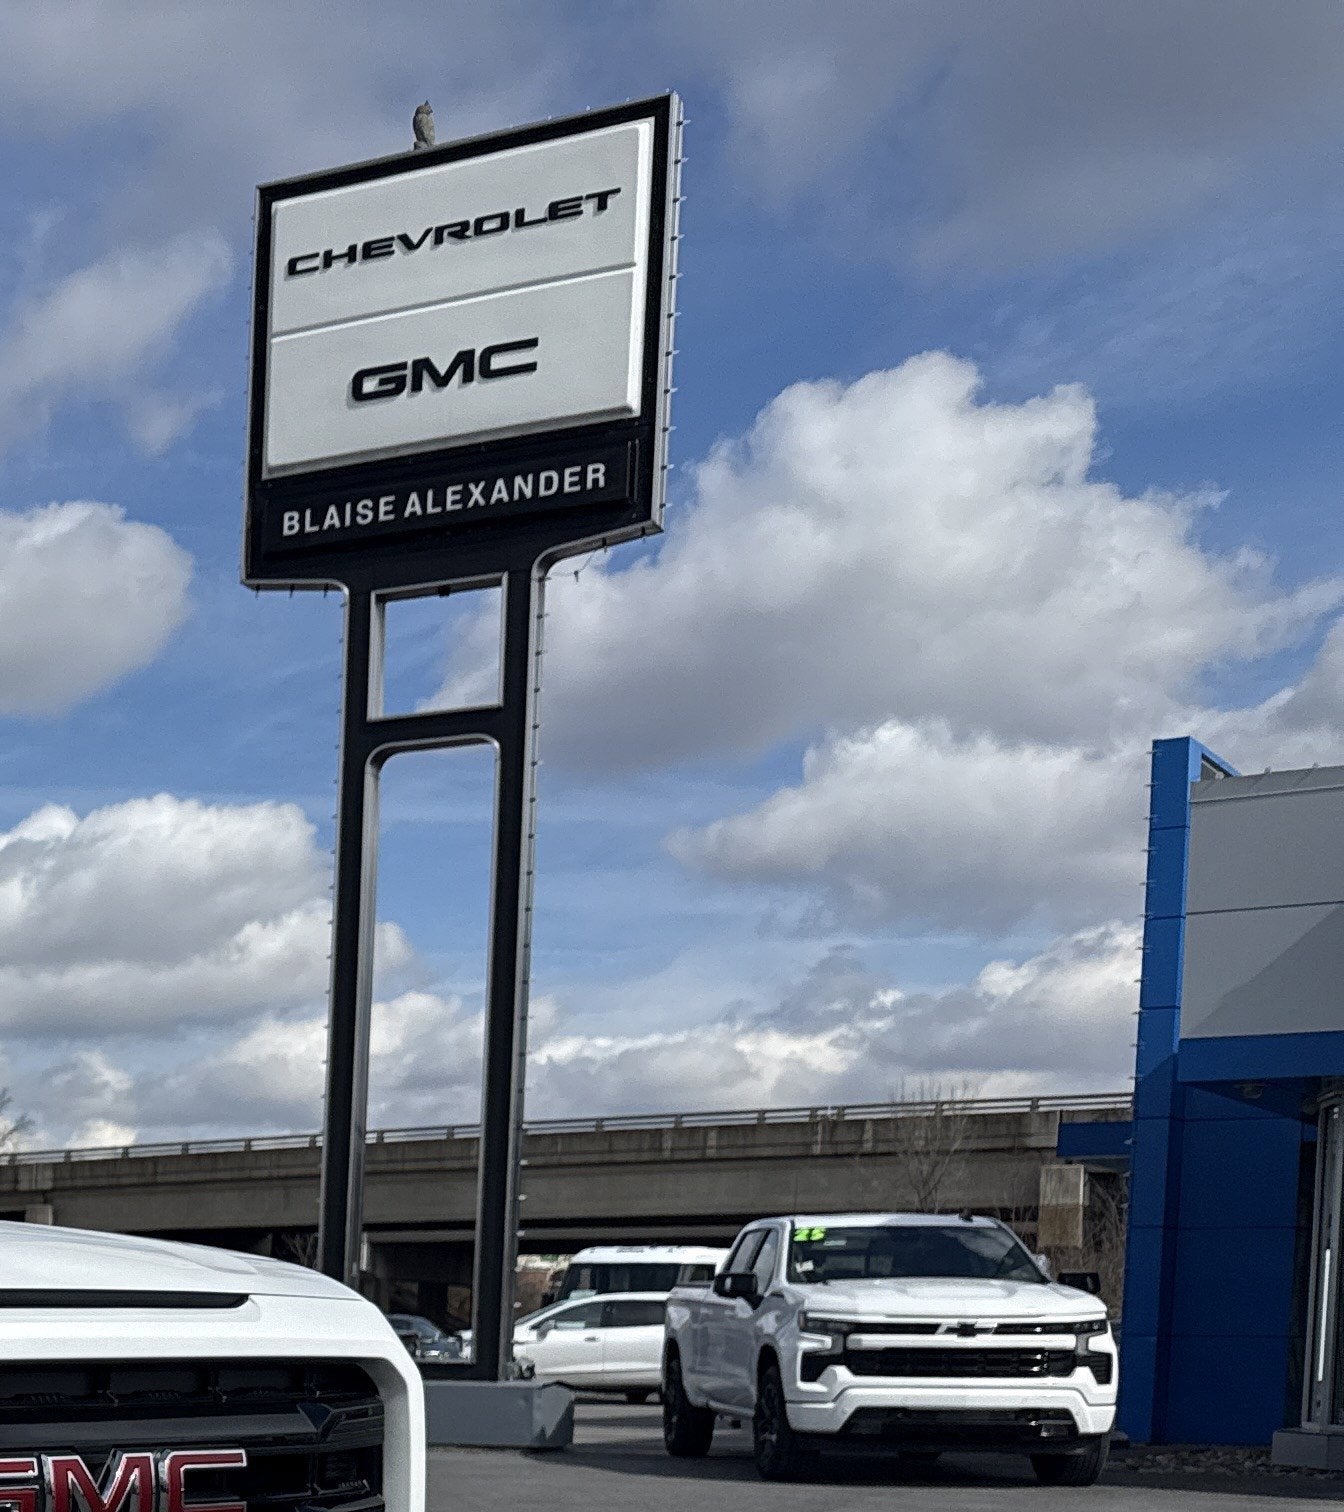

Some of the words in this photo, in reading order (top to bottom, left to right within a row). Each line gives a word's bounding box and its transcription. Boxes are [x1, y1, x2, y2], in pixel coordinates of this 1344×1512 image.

[286, 187, 622, 277] CHEVROLET
[349, 336, 540, 403] GMC
[281, 493, 397, 538] BLAISE
[403, 461, 608, 519] ALEXANDER
